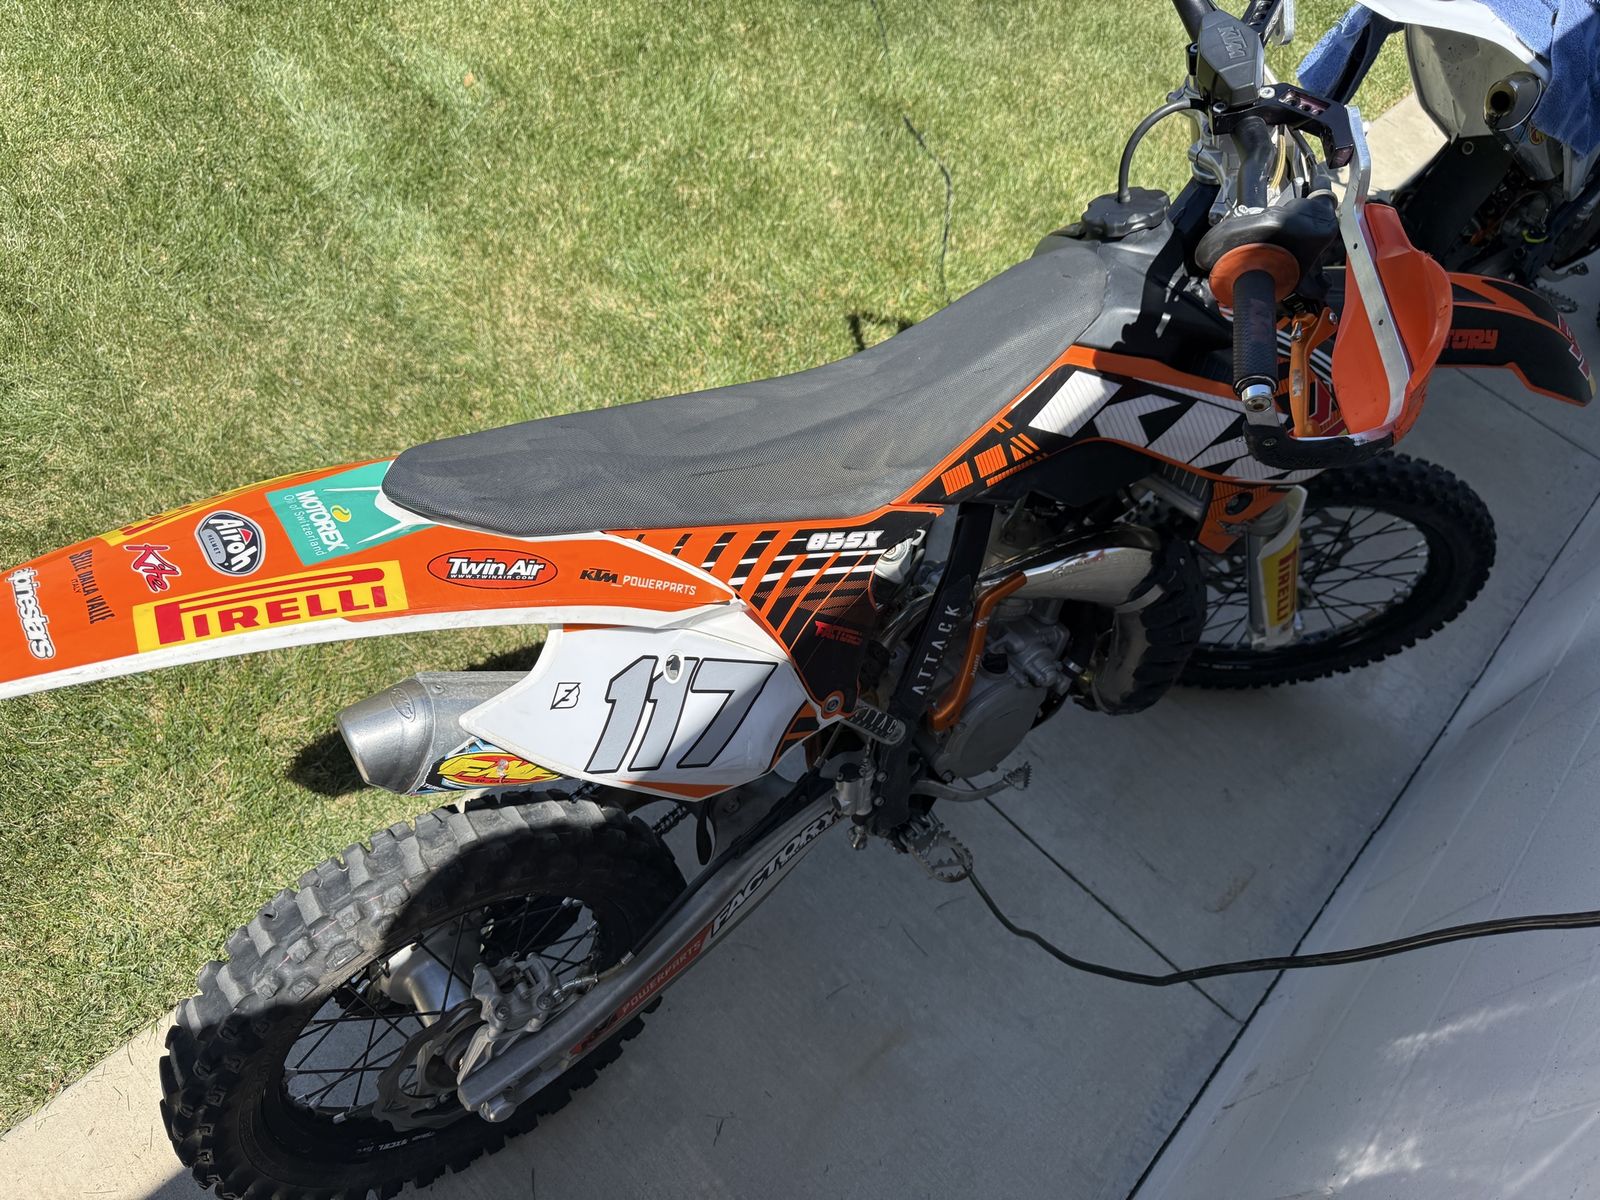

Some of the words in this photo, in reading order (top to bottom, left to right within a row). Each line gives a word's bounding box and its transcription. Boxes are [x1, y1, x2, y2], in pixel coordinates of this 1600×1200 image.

[1217, 26, 1248, 59] KTM
[294, 509, 328, 556] Switzerland
[295, 490, 347, 552] MOTOREX
[806, 530, 885, 551] 85SX
[69, 549, 93, 572] SELLE
[207, 534, 222, 555] HELMET
[208, 518, 258, 571] Airoh
[447, 557, 507, 575] Twin
[507, 558, 546, 576] Air
[71, 578, 82, 594] ITALY
[77, 570, 99, 596] DALLA
[125, 546, 181, 592] Kite
[580, 567, 618, 584] KTM
[1277, 549, 1298, 620] PIRELLI
[86, 595, 116, 625] VALLE
[154, 567, 388, 645] PIRELLI
[912, 605, 960, 695] ATTACK
[583, 655, 779, 775] 117
[710, 808, 841, 939] FACTORY
[621, 940, 703, 1015] POWERPARTS
